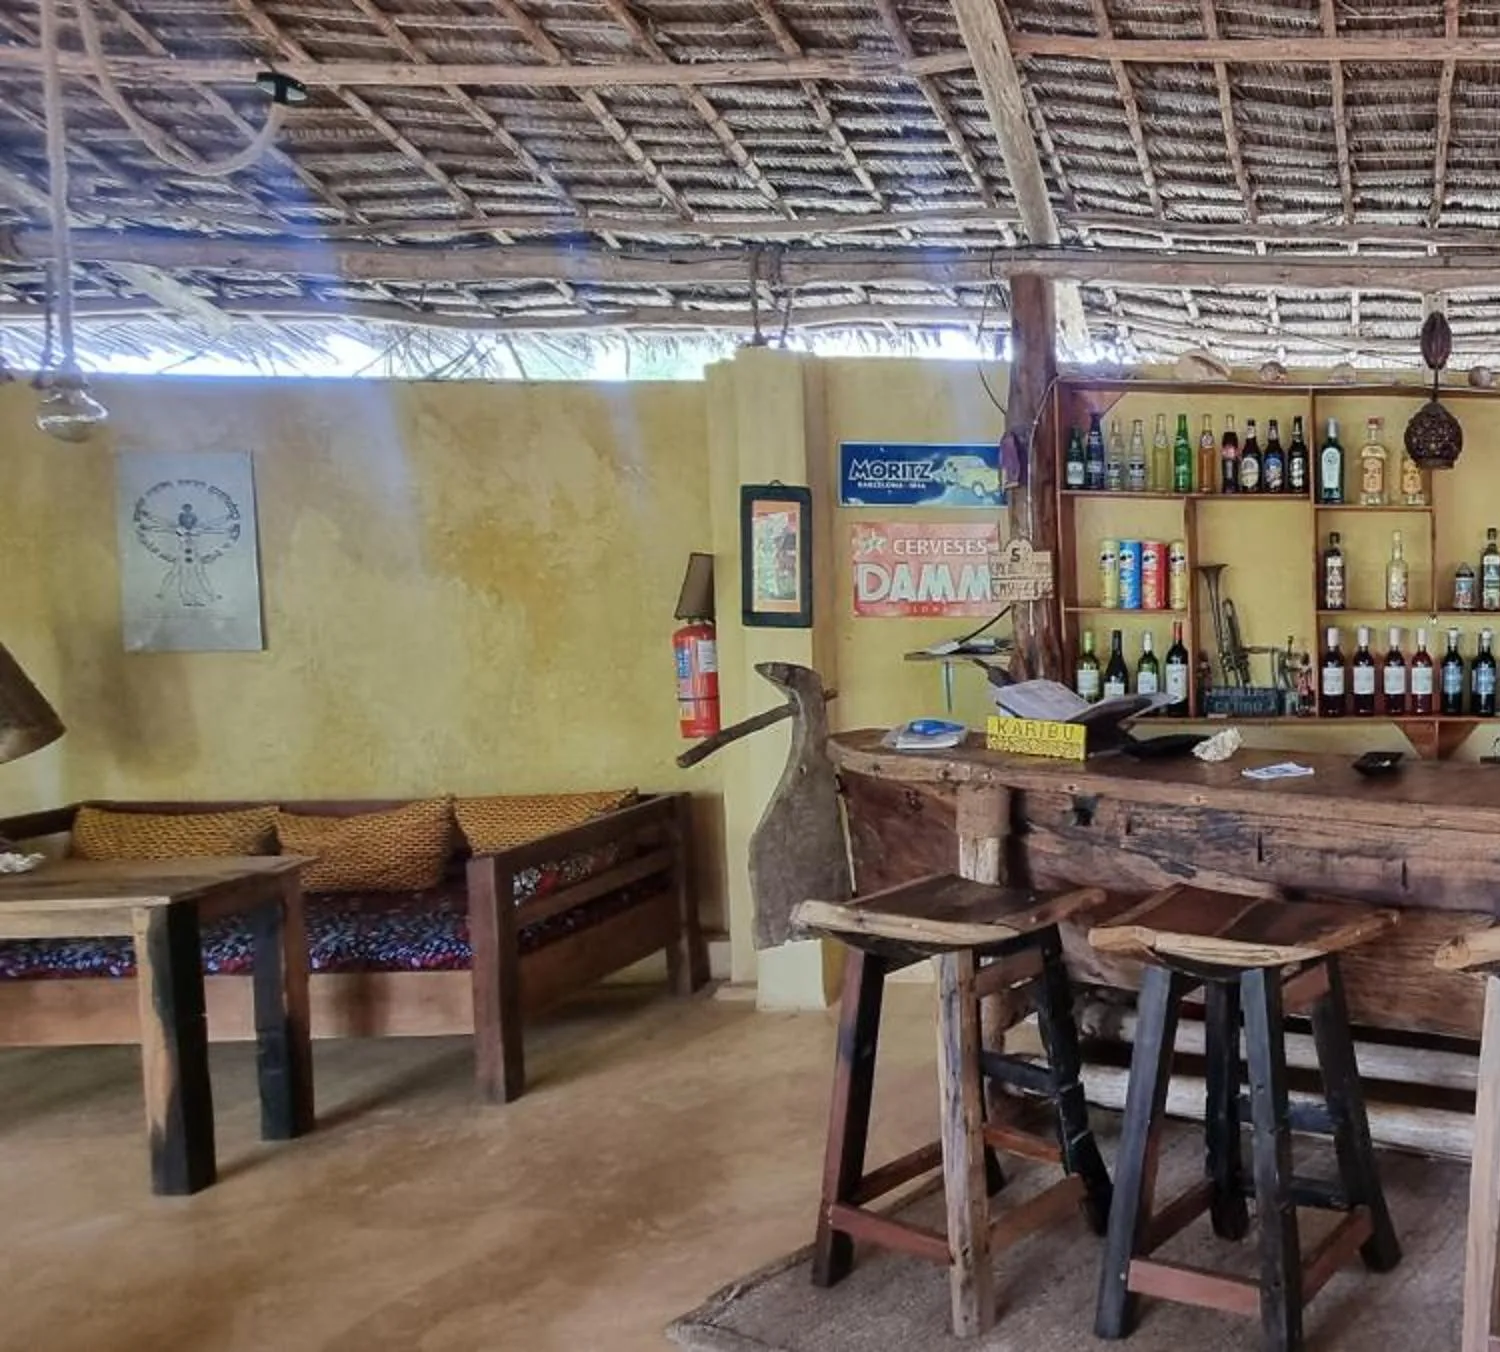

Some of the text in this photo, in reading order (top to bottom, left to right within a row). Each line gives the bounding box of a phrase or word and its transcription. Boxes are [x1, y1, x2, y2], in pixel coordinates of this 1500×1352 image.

[849, 459, 936, 482] MORITZ
[893, 538, 988, 556] CERVESES
[856, 562, 994, 605] DAMM
[996, 718, 1074, 740] KARIBU
